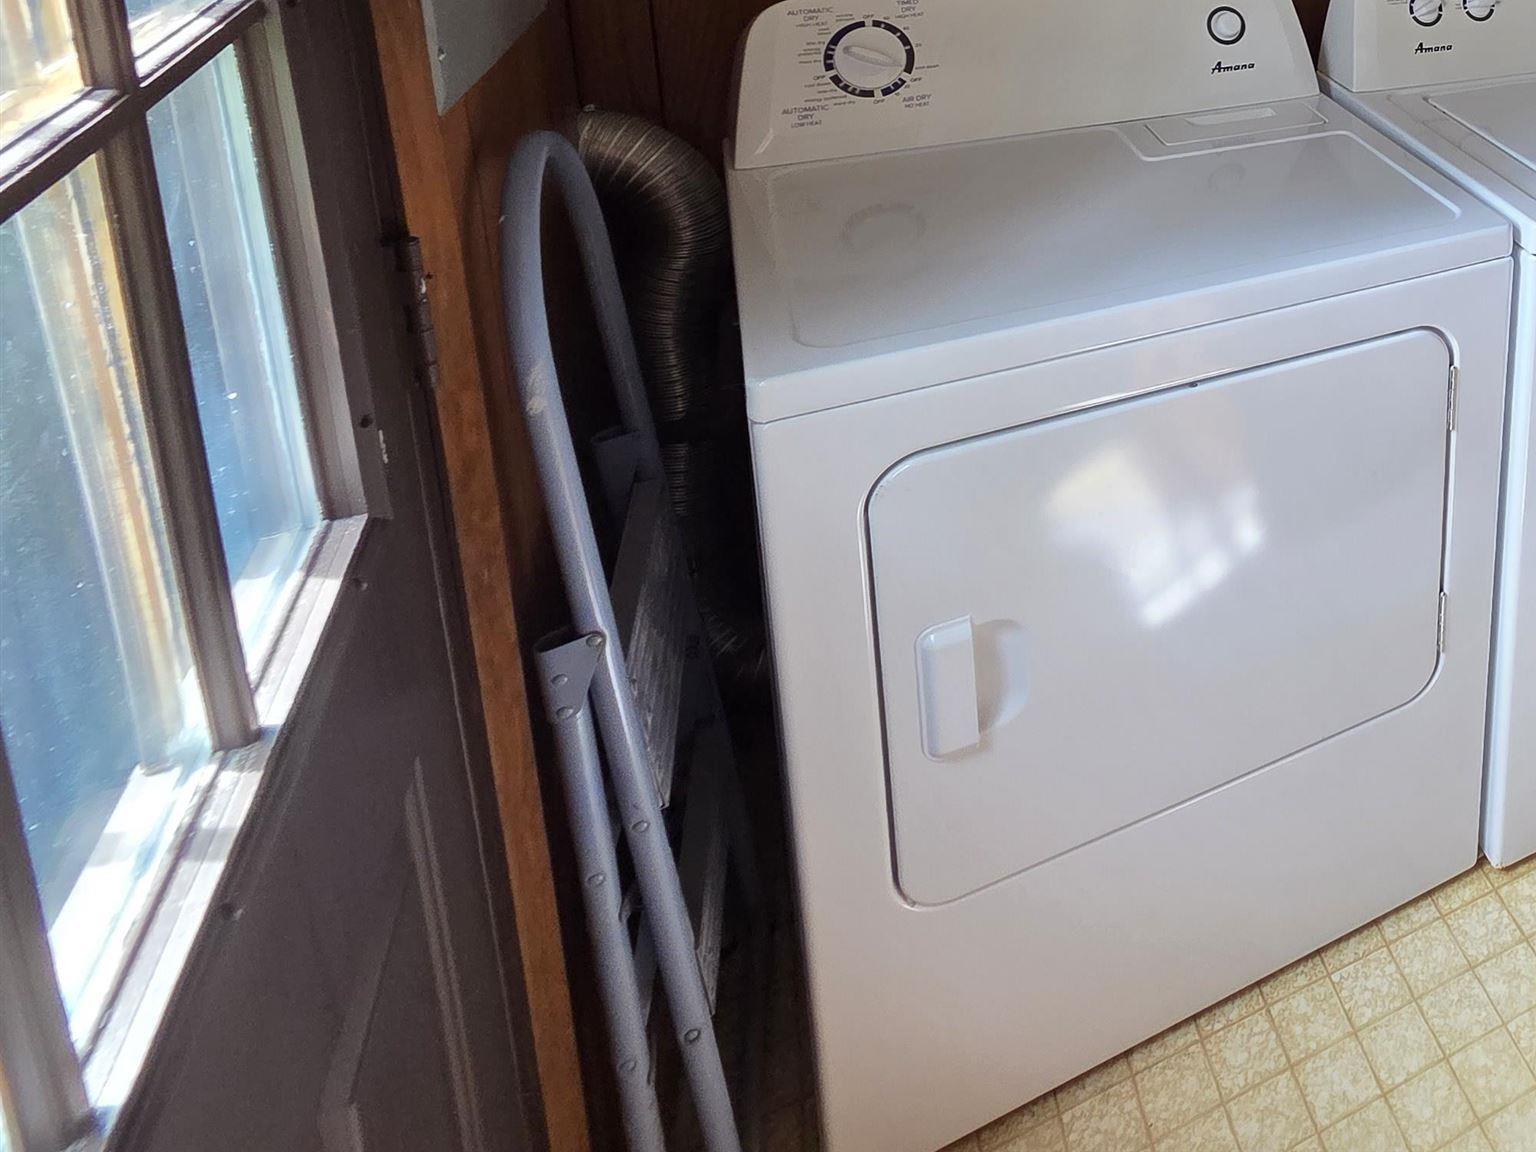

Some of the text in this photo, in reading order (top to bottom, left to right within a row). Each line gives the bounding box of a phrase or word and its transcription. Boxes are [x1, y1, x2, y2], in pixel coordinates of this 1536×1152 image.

[787, 7, 833, 16] AUTOMATIC
[1415, 42, 1453, 54] Amana
[1210, 61, 1255, 74] Amana
[782, 104, 830, 115] AUTOMATIC
[797, 113, 814, 121] DRY
